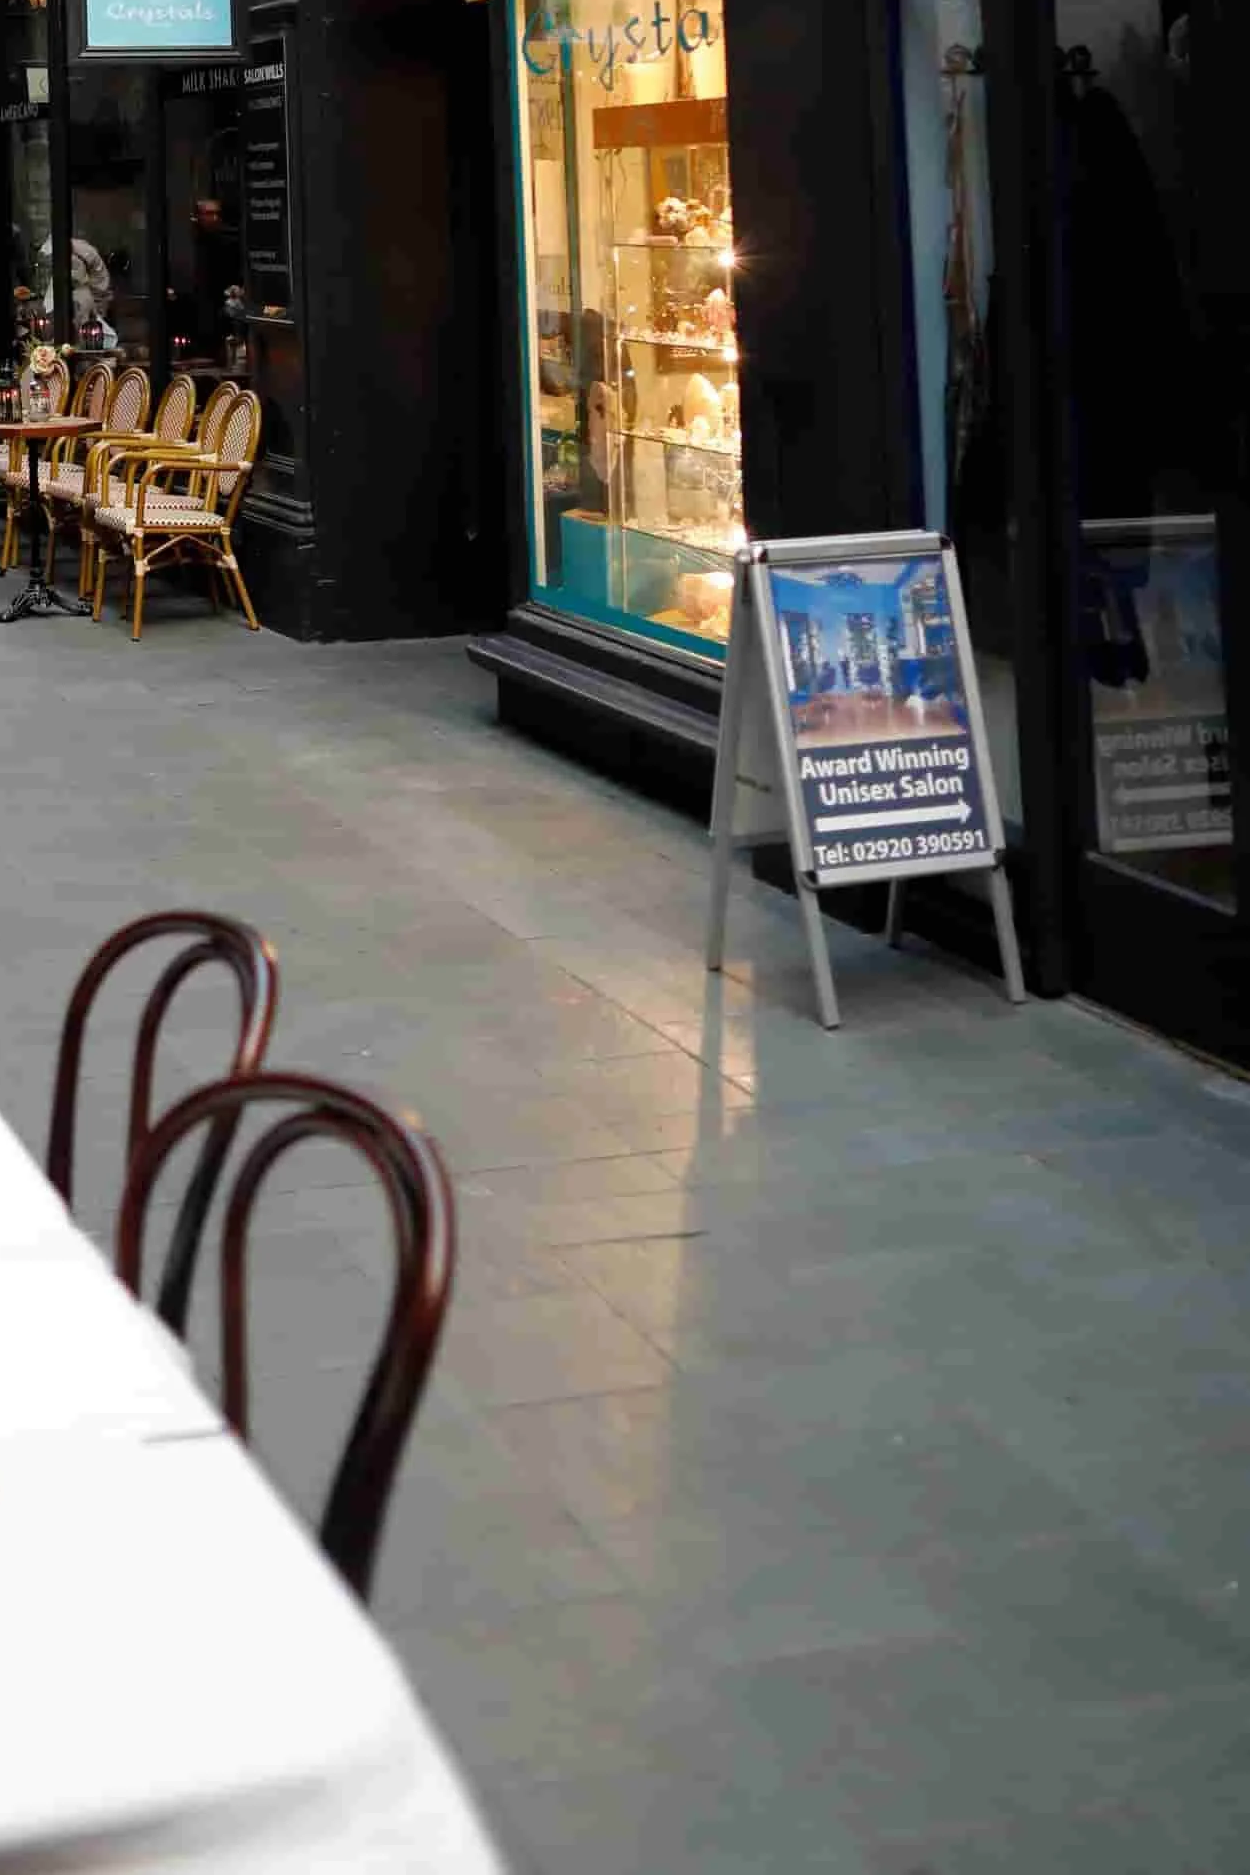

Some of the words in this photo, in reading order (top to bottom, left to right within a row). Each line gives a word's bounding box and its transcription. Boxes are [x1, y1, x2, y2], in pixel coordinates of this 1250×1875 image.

[801, 750, 873, 779] Award
[874, 743, 970, 771] Winning
[819, 780, 897, 806] Unisex
[899, 772, 964, 798] Salon
[814, 842, 850, 865] Tel:
[853, 837, 913, 862] 02920
[915, 829, 986, 855] 390591
